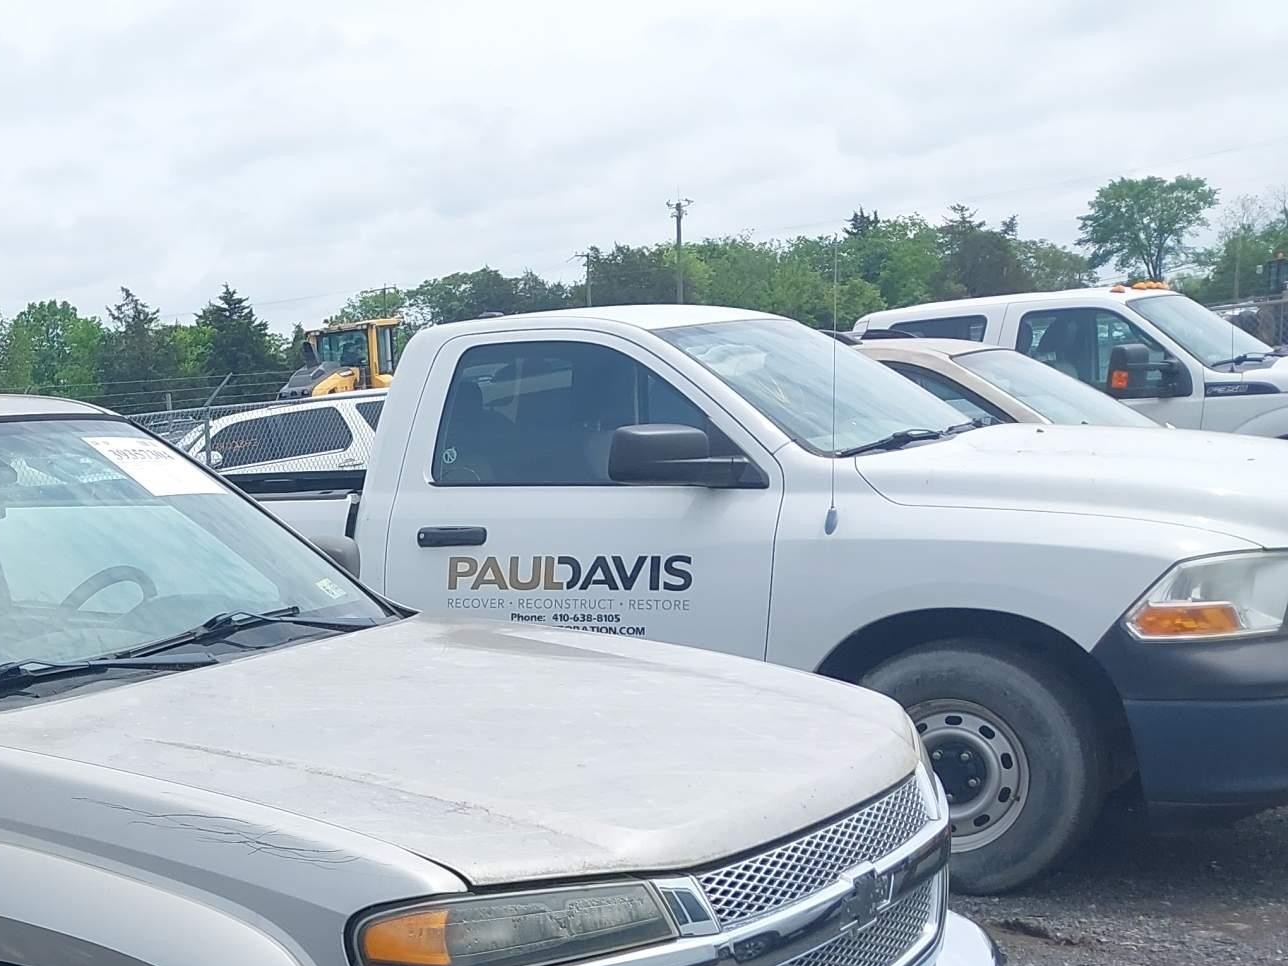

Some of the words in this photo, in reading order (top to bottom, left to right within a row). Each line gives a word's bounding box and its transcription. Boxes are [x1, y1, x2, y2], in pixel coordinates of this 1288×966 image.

[447, 598, 505, 609] RECOVER
[517, 598, 614, 610] RECONSTRUCT
[628, 599, 690, 611] RESTORE
[510, 612, 546, 622] Phone:
[552, 613, 621, 623] 410-638-8105
